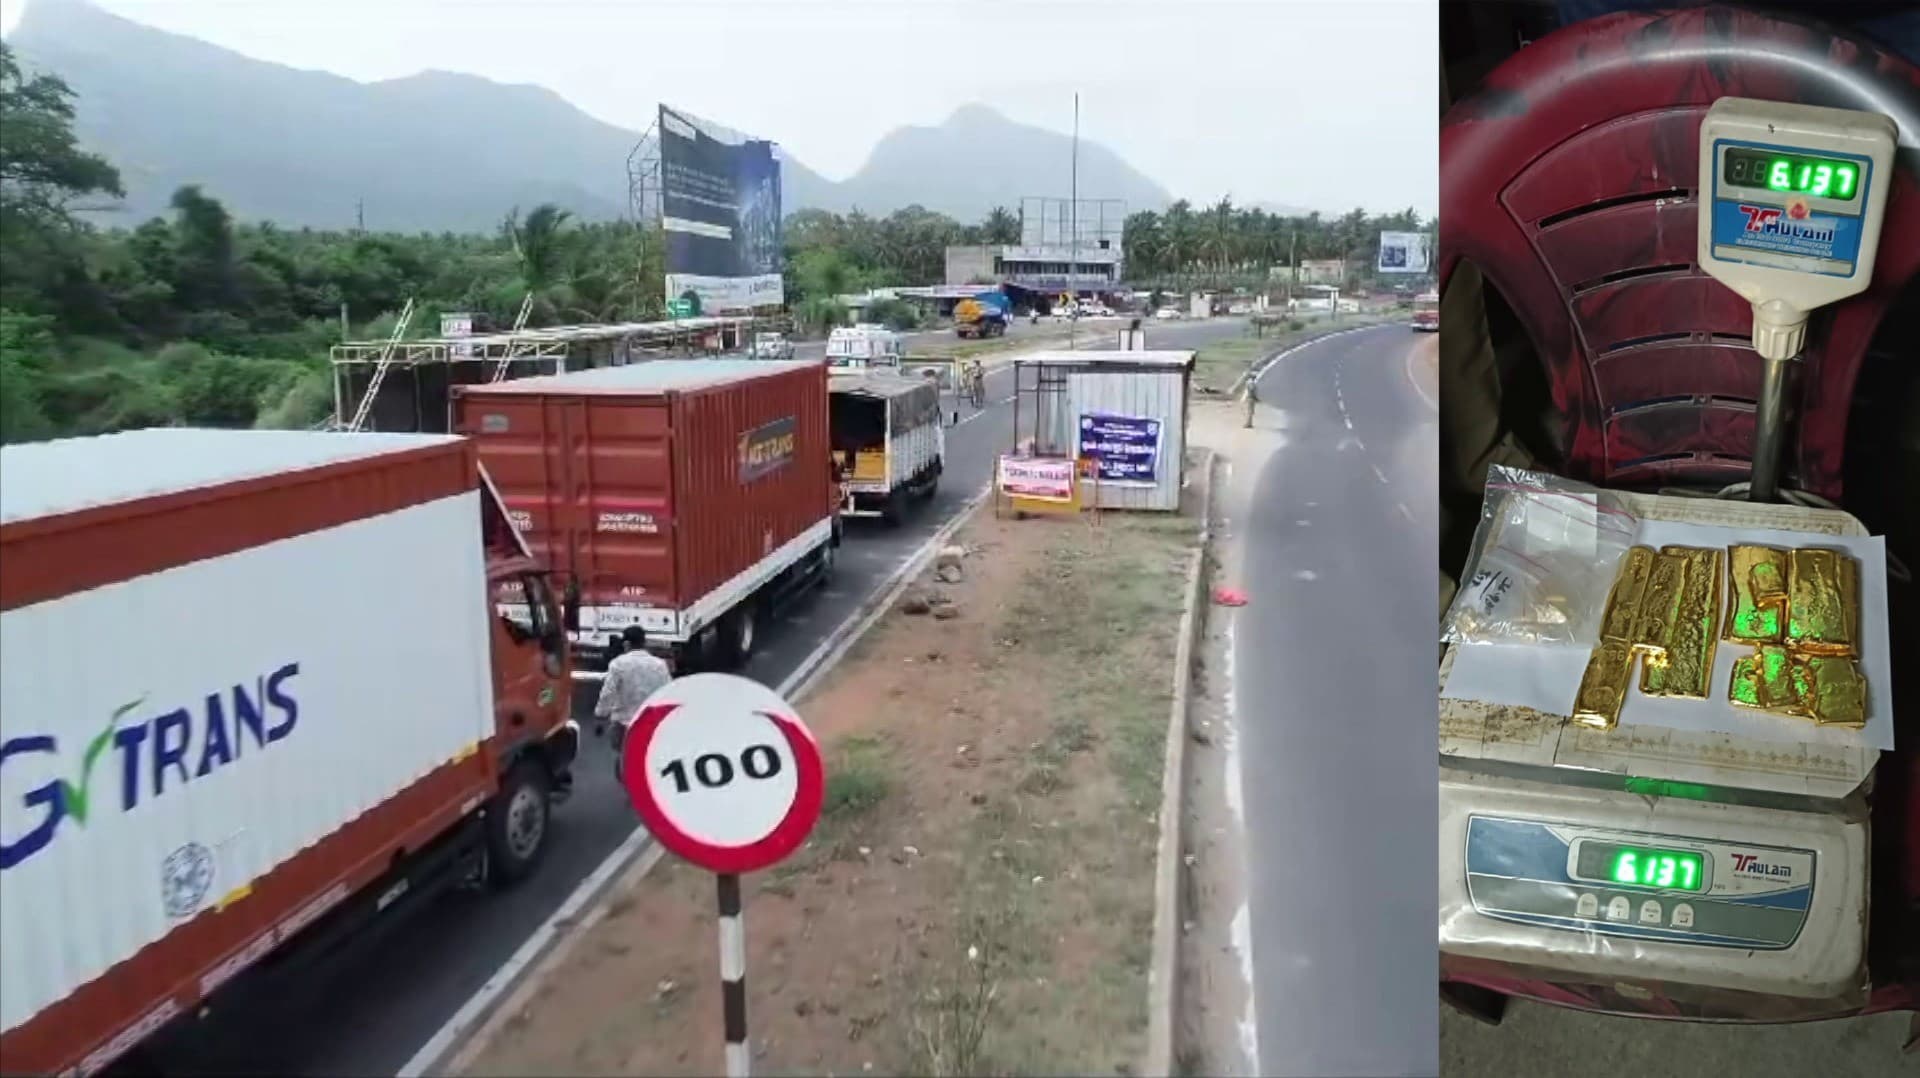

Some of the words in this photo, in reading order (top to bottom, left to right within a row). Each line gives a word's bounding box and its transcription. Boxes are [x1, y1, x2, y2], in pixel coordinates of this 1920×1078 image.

[1771, 161, 1854, 194] 6.137
[660, 744, 782, 793] 100
[1617, 852, 1696, 888] 6.137
